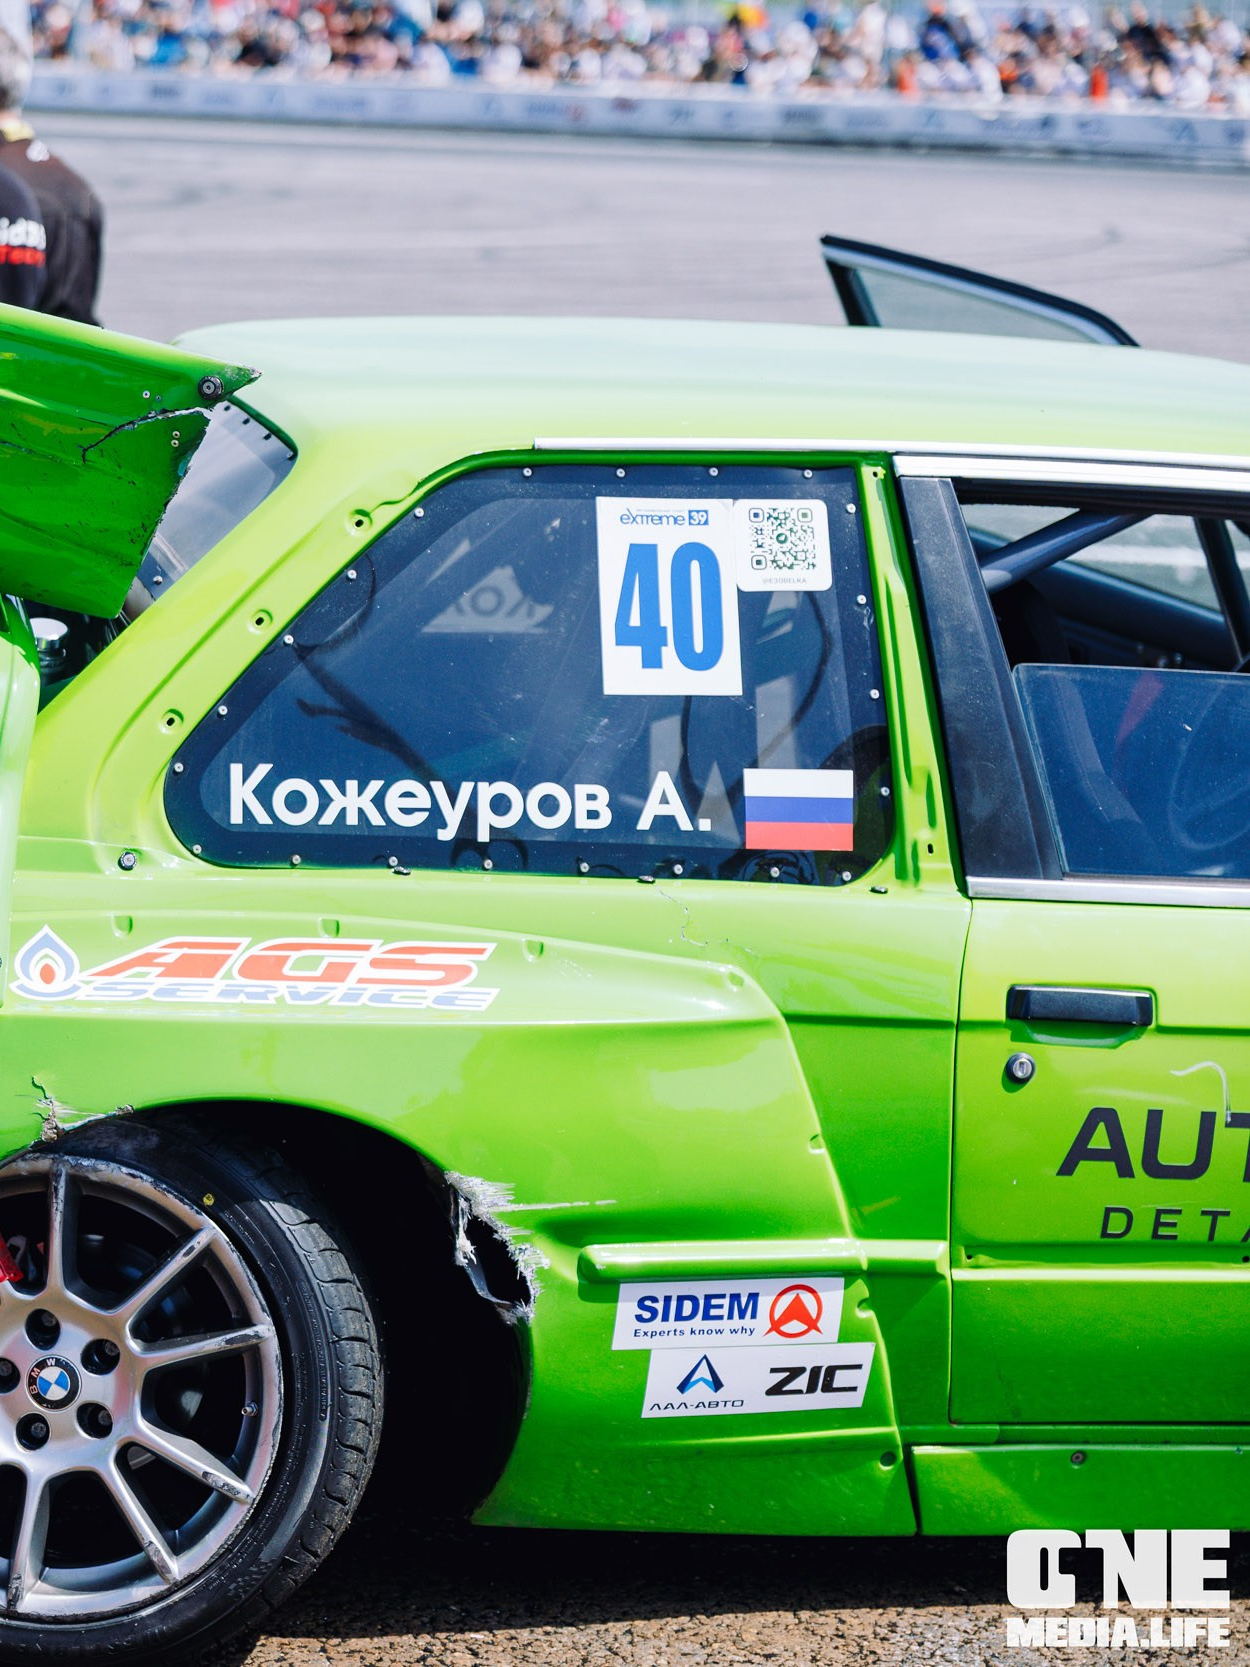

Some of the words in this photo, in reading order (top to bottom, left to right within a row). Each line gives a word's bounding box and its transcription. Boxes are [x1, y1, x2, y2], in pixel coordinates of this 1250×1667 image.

[689, 510, 709, 526] 39
[614, 541, 724, 672] 40
[228, 763, 612, 842] Кожеуров
[636, 770, 712, 832] А.
[81, 937, 496, 986] AGS
[77, 981, 499, 1010] SERVICE
[634, 1292, 760, 1323] SIDEM
[634, 1327, 685, 1338] Experts
[690, 1327, 724, 1336] know
[729, 1326, 756, 1336] why
[29, 1358, 56, 1395] BMW
[765, 1363, 863, 1396] ZIC
